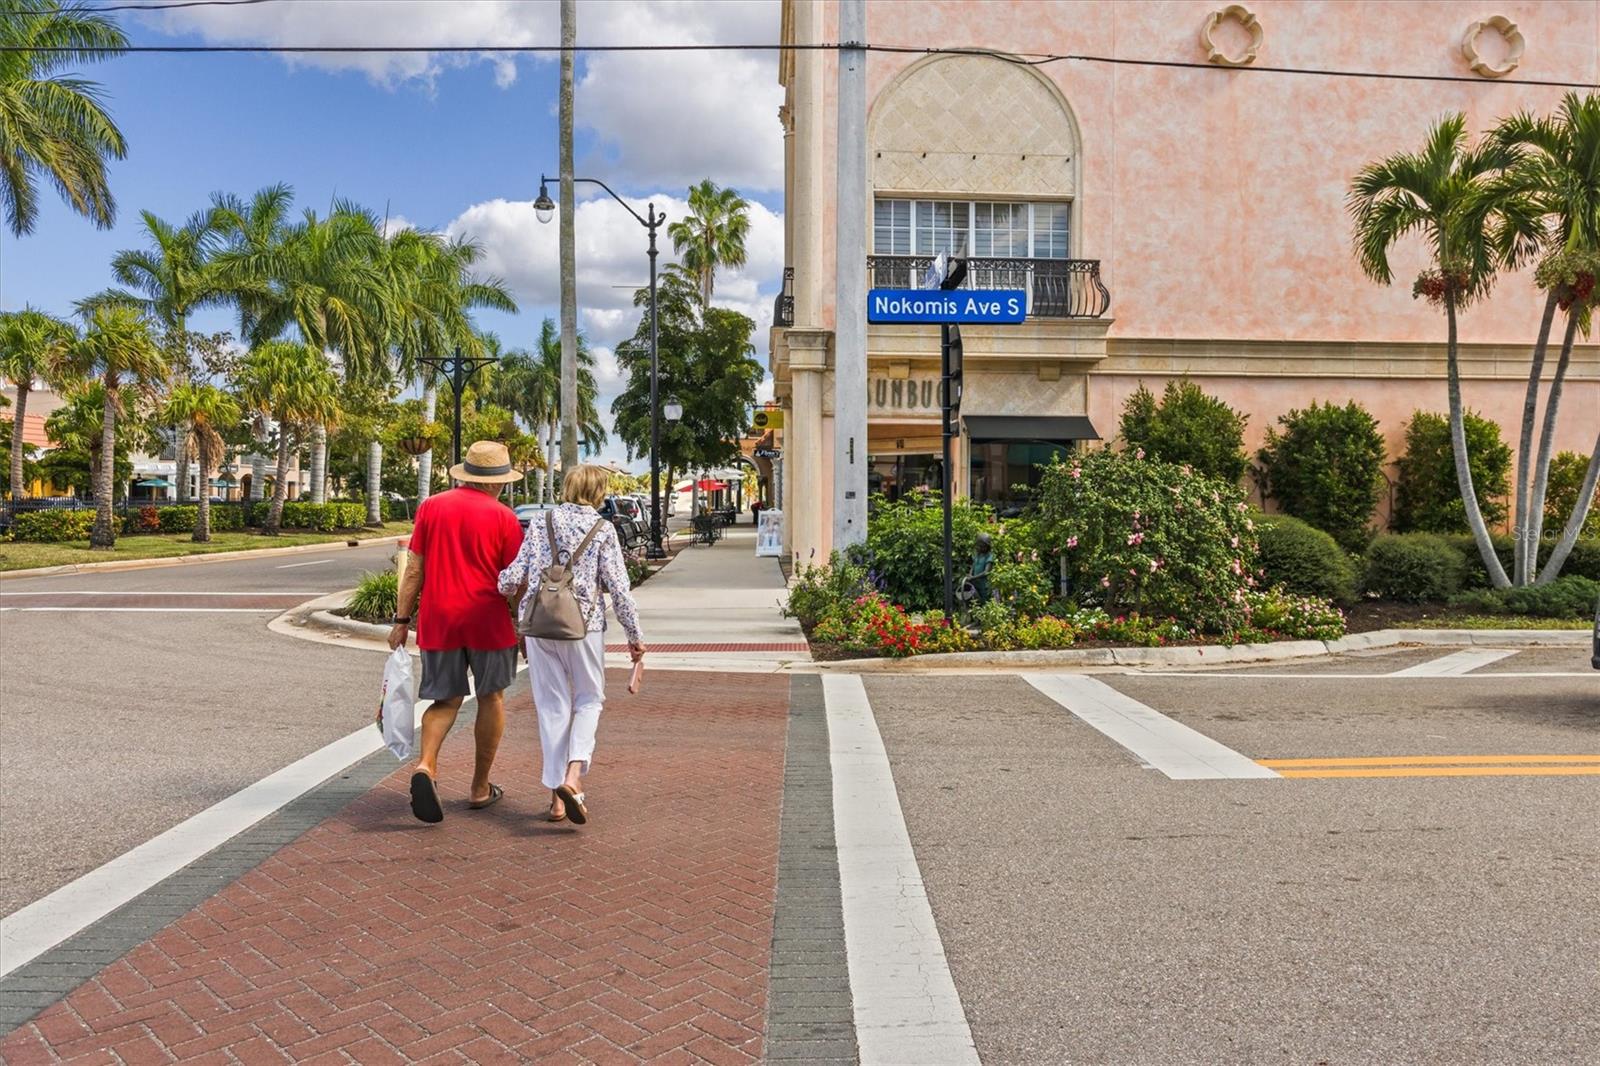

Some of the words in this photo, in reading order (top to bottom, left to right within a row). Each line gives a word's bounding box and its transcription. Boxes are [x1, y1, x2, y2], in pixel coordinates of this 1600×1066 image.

[875, 296, 957, 315] Nokomis
[964, 297, 1001, 315] Ave
[1007, 298, 1020, 315] S
